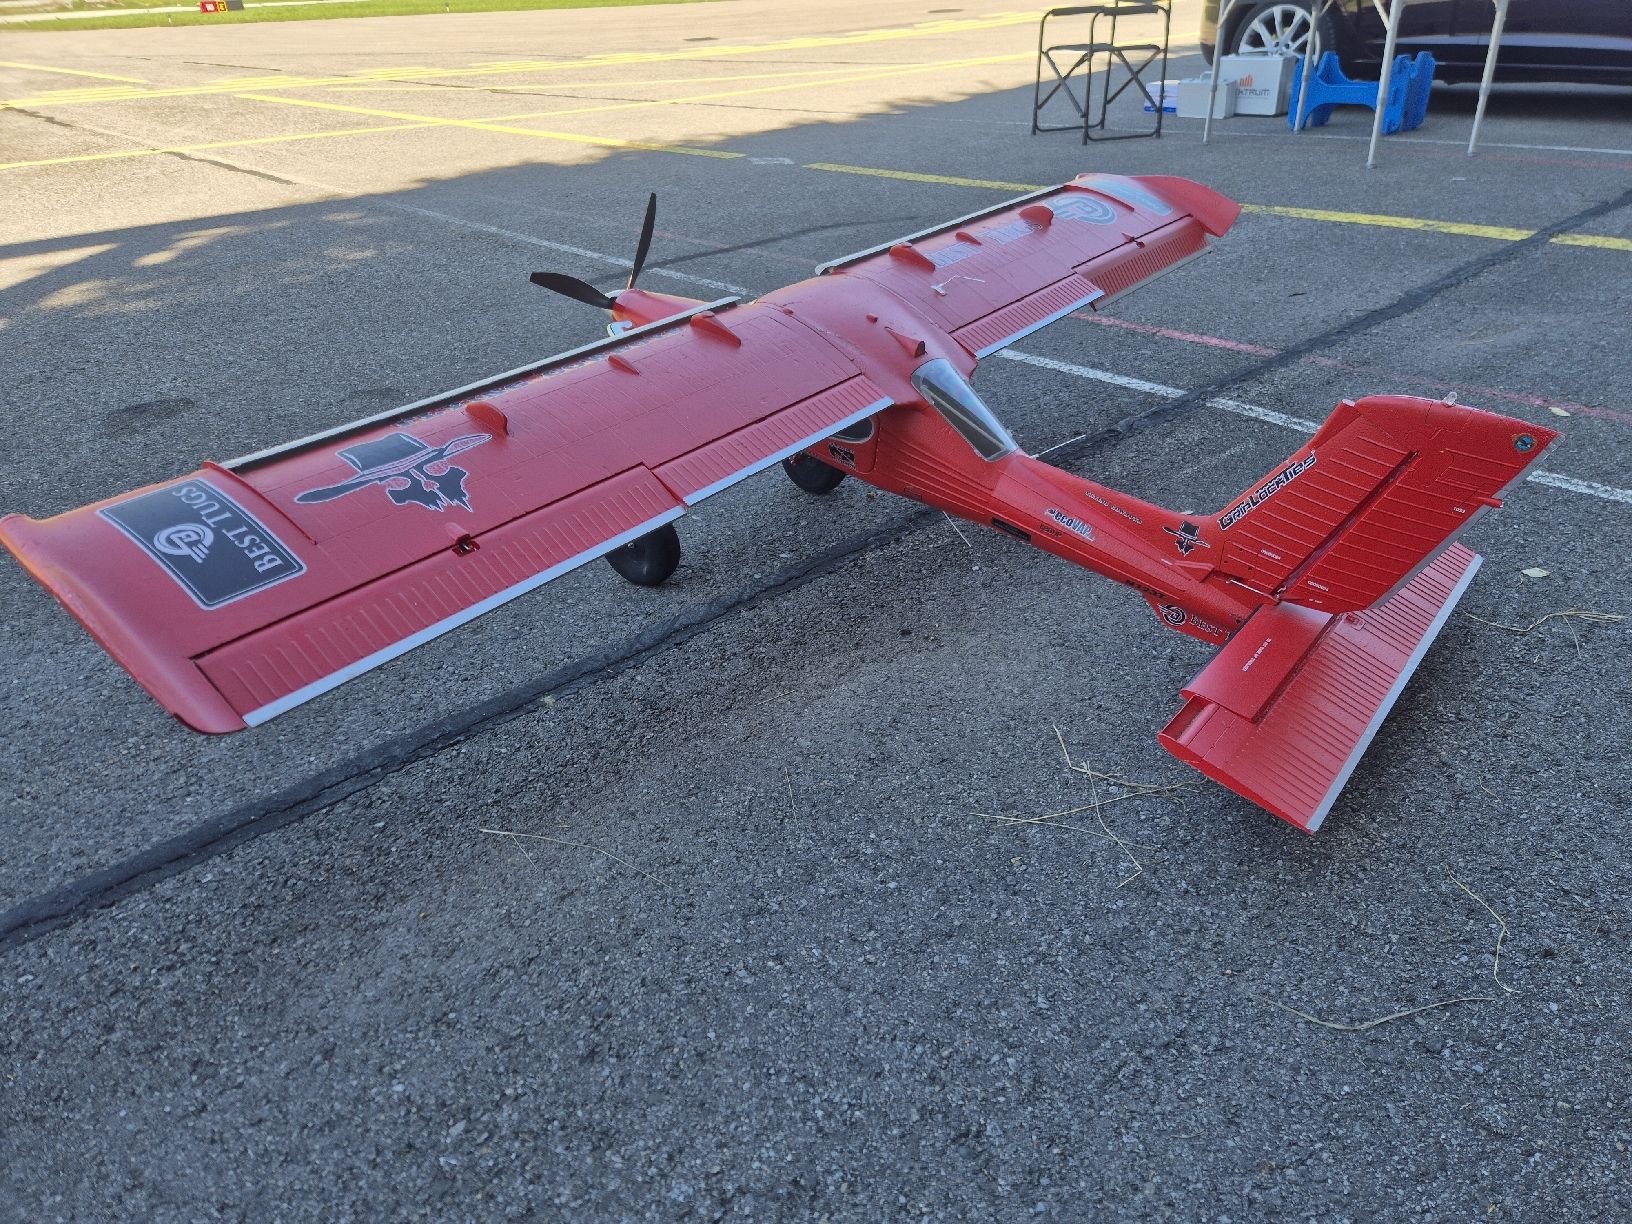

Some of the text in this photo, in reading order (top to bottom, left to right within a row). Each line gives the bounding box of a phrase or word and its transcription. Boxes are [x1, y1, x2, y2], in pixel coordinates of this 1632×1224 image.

[172, 486, 284, 574] BEST TUGS
[1190, 614, 1222, 637] BEST
